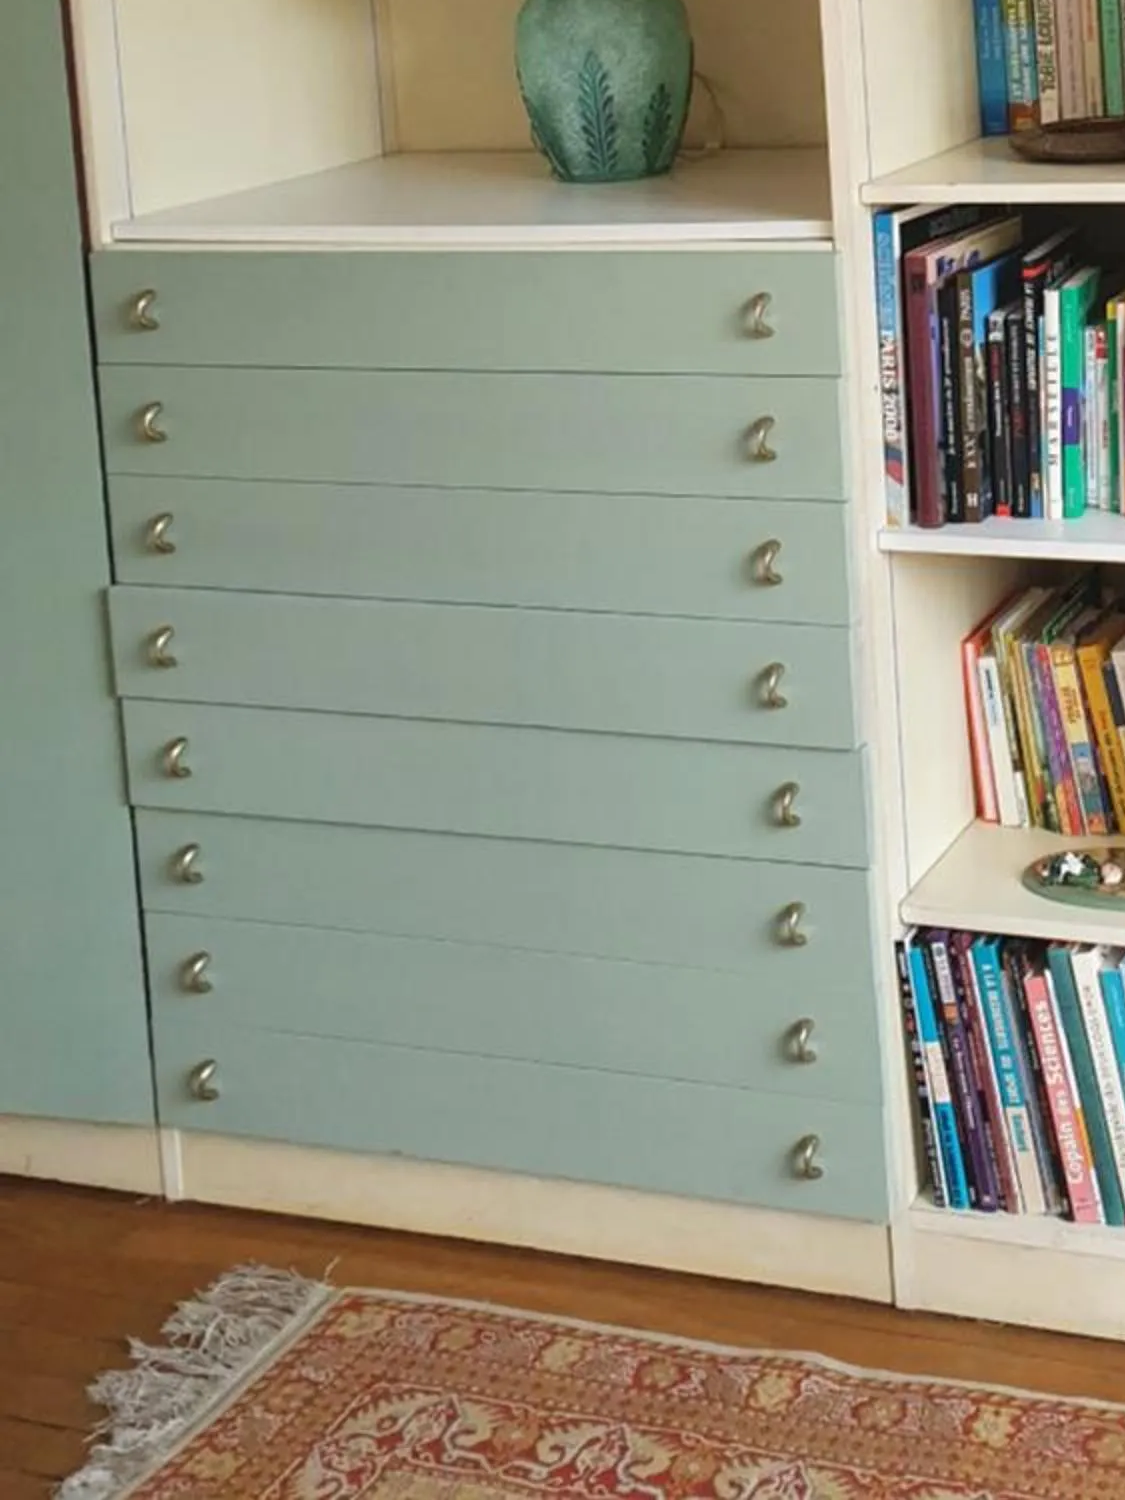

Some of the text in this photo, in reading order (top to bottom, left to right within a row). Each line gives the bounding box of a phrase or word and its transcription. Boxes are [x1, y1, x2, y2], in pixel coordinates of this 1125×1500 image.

[1024, 297, 1035, 331] FRANCE
[879, 328, 899, 389] PARIS
[881, 391, 901, 441] 2000
[1046, 333, 1059, 466] MARSEILLE
[1032, 999, 1064, 1086] Sciences
[1060, 1120, 1085, 1186] Copain
